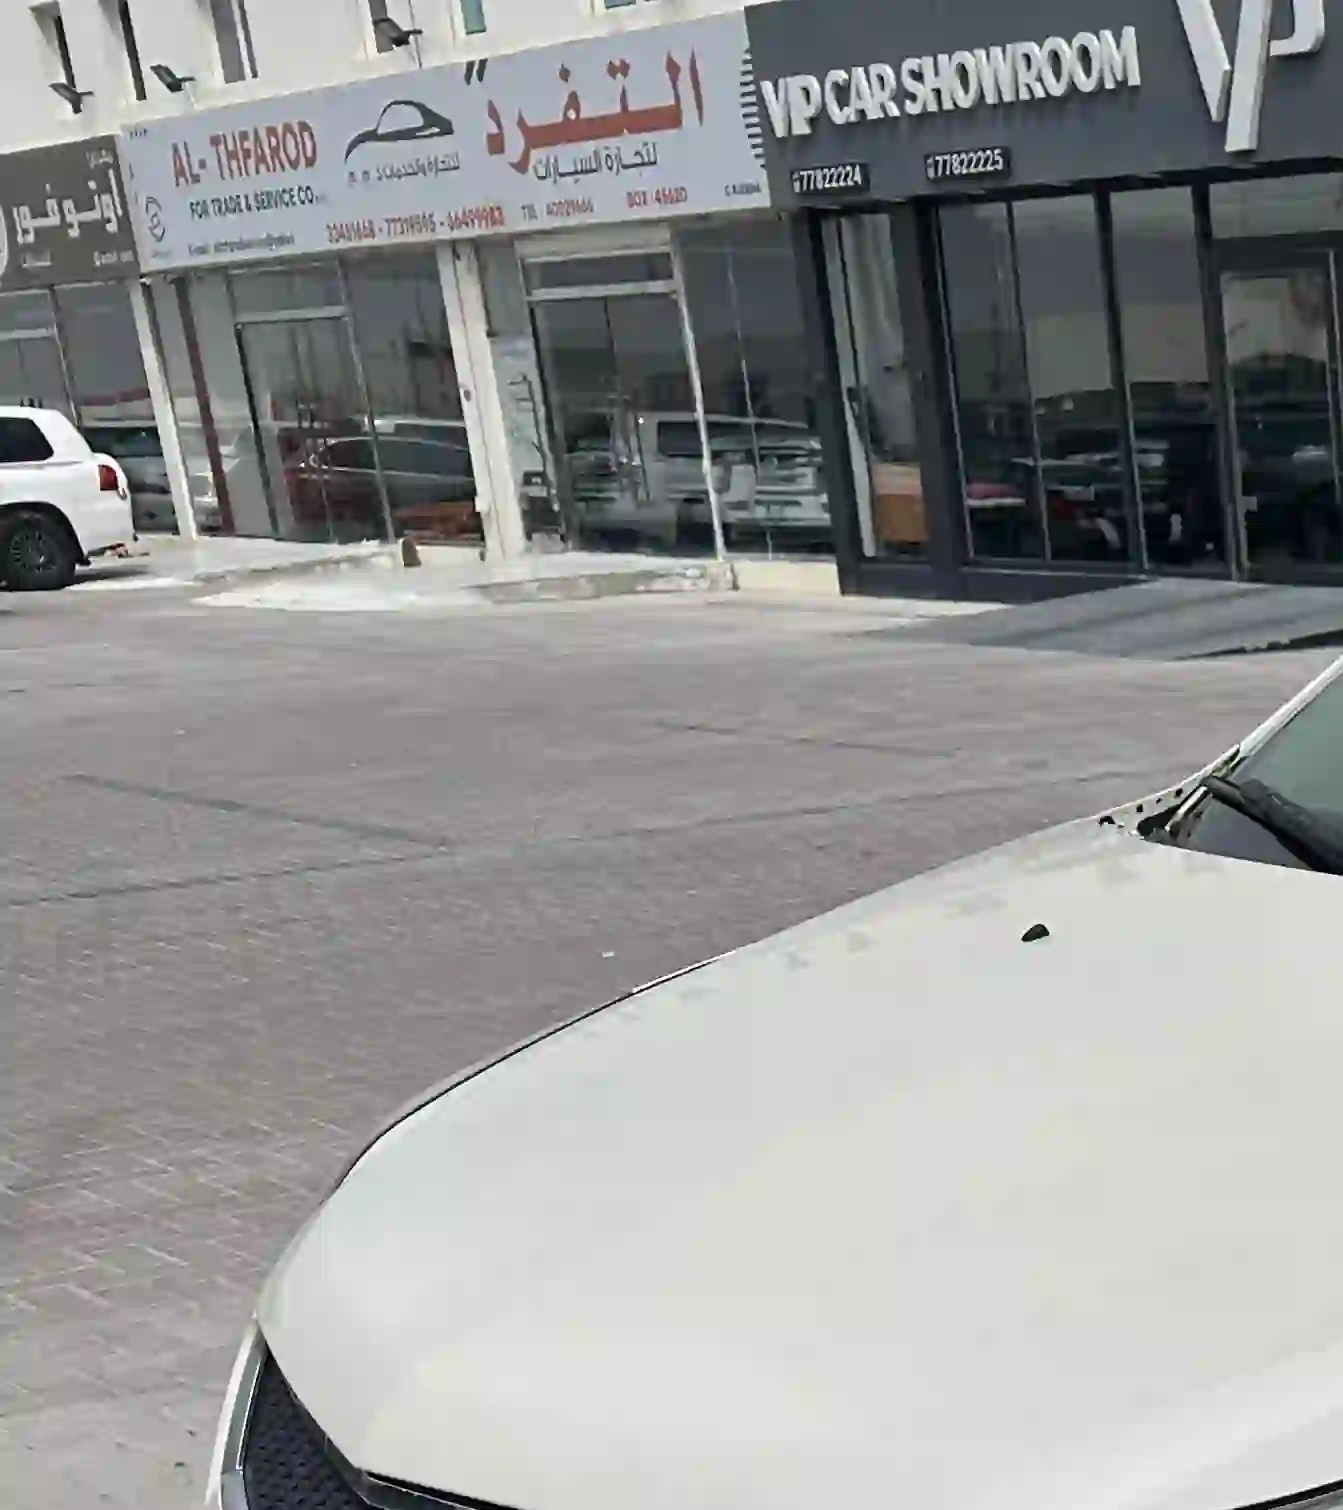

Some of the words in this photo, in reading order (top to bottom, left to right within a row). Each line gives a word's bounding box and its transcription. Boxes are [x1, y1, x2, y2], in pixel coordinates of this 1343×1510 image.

[760, 75, 822, 138] VIP
[825, 62, 900, 125] CAR
[901, 26, 1141, 115] SHOWROOM
[209, 120, 318, 181] THFAROD
[936, 149, 1004, 178] 77822225
[799, 164, 862, 192] 77822224
[189, 200, 210, 220] FOR
[211, 195, 243, 217] TRADE
[254, 187, 296, 213] SERVICE
